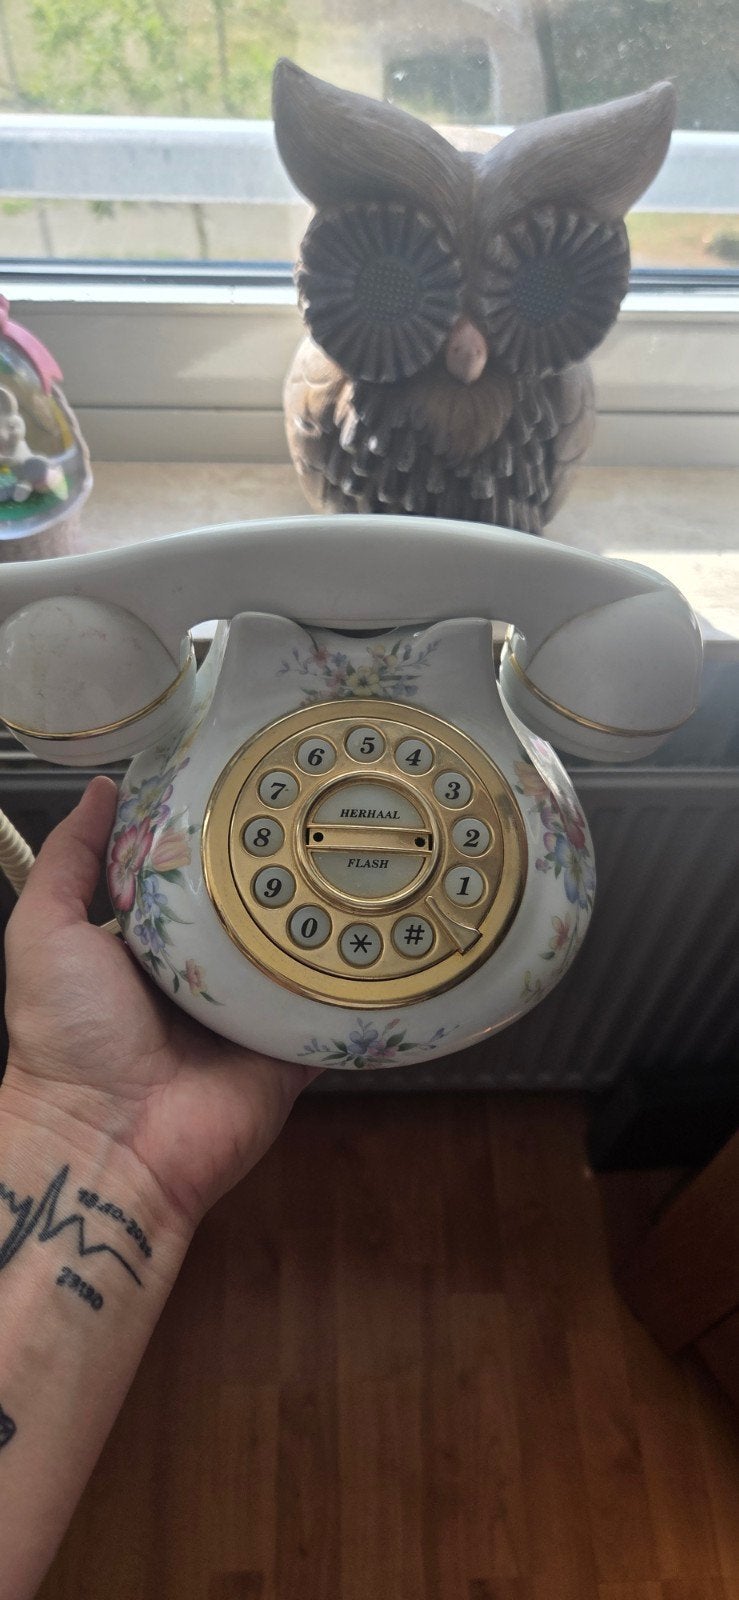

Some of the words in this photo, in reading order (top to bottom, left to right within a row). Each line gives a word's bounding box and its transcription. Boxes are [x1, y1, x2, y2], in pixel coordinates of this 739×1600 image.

[359, 736, 376, 755] 5
[307, 747, 326, 767] 6
[405, 748, 422, 767] 4
[270, 782, 287, 801] 7
[444, 781, 460, 800] 3
[340, 808, 401, 820] HERHAAL
[253, 827, 271, 848] 8
[463, 828, 481, 848] 2
[347, 858, 390, 869] FLASH
[263, 877, 283, 898] 9
[456, 876, 470, 896] 1
[301, 917, 318, 939] 0
[404, 924, 425, 945] #
